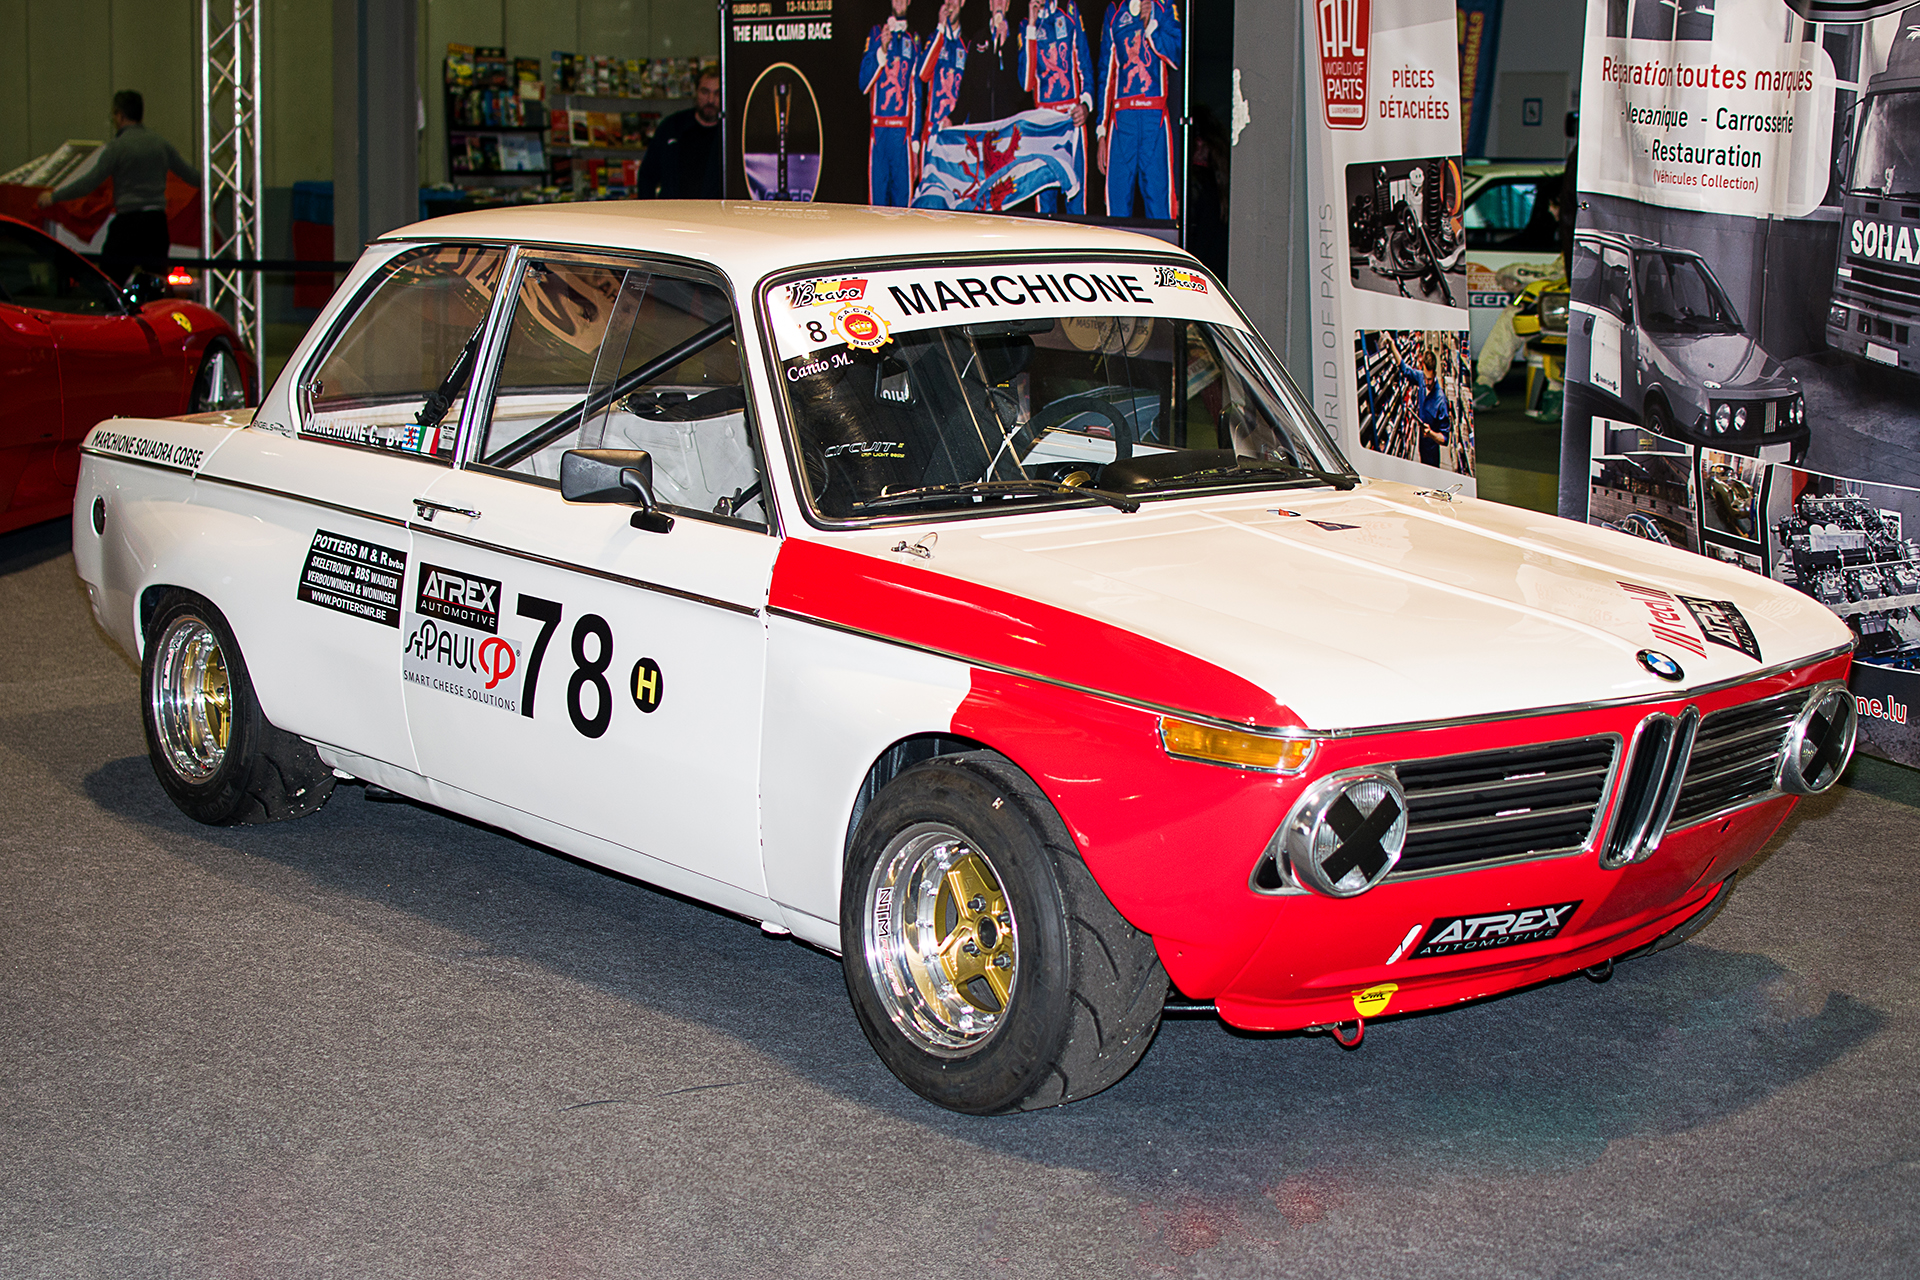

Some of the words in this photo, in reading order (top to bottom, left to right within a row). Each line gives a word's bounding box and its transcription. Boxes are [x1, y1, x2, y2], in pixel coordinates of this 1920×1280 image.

[733, 25, 751, 42] THE
[753, 24, 774, 41] HILL
[776, 22, 806, 41] CLIMB
[808, 22, 832, 40] RACE
[1324, 61, 1350, 76] WORLD
[1353, 61, 1364, 75] OF
[1392, 64, 1435, 89] PIÈCES
[1602, 55, 1673, 90] Réparation
[1676, 62, 1747, 90] toutes
[1755, 69, 1813, 99] marques
[1326, 78, 1364, 100] PARTS
[1379, 95, 1450, 120] DÉTACHÉES
[1716, 107, 1794, 134] Carrosserie
[1652, 139, 1762, 169] Restauration
[1653, 169, 1698, 186] (Véhicules
[1701, 174, 1759, 193] Collection)
[1318, 203, 1335, 299] PARTS
[793, 283, 862, 308] Bravo
[888, 273, 1154, 316] MARCHIONE
[1161, 270, 1206, 292] Bravo
[852, 334, 884, 347] SPORT
[1321, 309, 1336, 349] OF
[787, 358, 830, 382] Canio
[831, 352, 854, 369] M.
[304, 412, 368, 442] MARCHIONE
[91, 430, 137, 455] MARCHIONE
[136, 438, 172, 463] SQUADRA
[173, 445, 204, 469] CORSE
[313, 534, 358, 556] POTTERS
[358, 545, 369, 560] M
[369, 549, 378, 563] &
[379, 551, 389, 566] R
[388, 557, 404, 570] bvba
[307, 570, 356, 594] VERBOUWINGEN
[355, 584, 362, 596] &
[362, 585, 397, 605] WONINGEN
[311, 555, 352, 577] SKELETBOUW
[354, 566, 371, 582] BBS
[370, 571, 398, 590] WANDEN
[311, 590, 387, 621] WWW.POTTERSMR.BE
[422, 570, 498, 613] ATREX
[420, 600, 497, 628] AUTOMOTIVE
[516, 593, 614, 739] 78
[403, 669, 431, 687] SMART
[433, 679, 464, 697] CHEESE
[467, 688, 516, 712] SOLUTIONS
[636, 666, 658, 705] H
[1429, 905, 1573, 943] ATREX
[1420, 929, 1557, 954] AUTOMOTIVE
